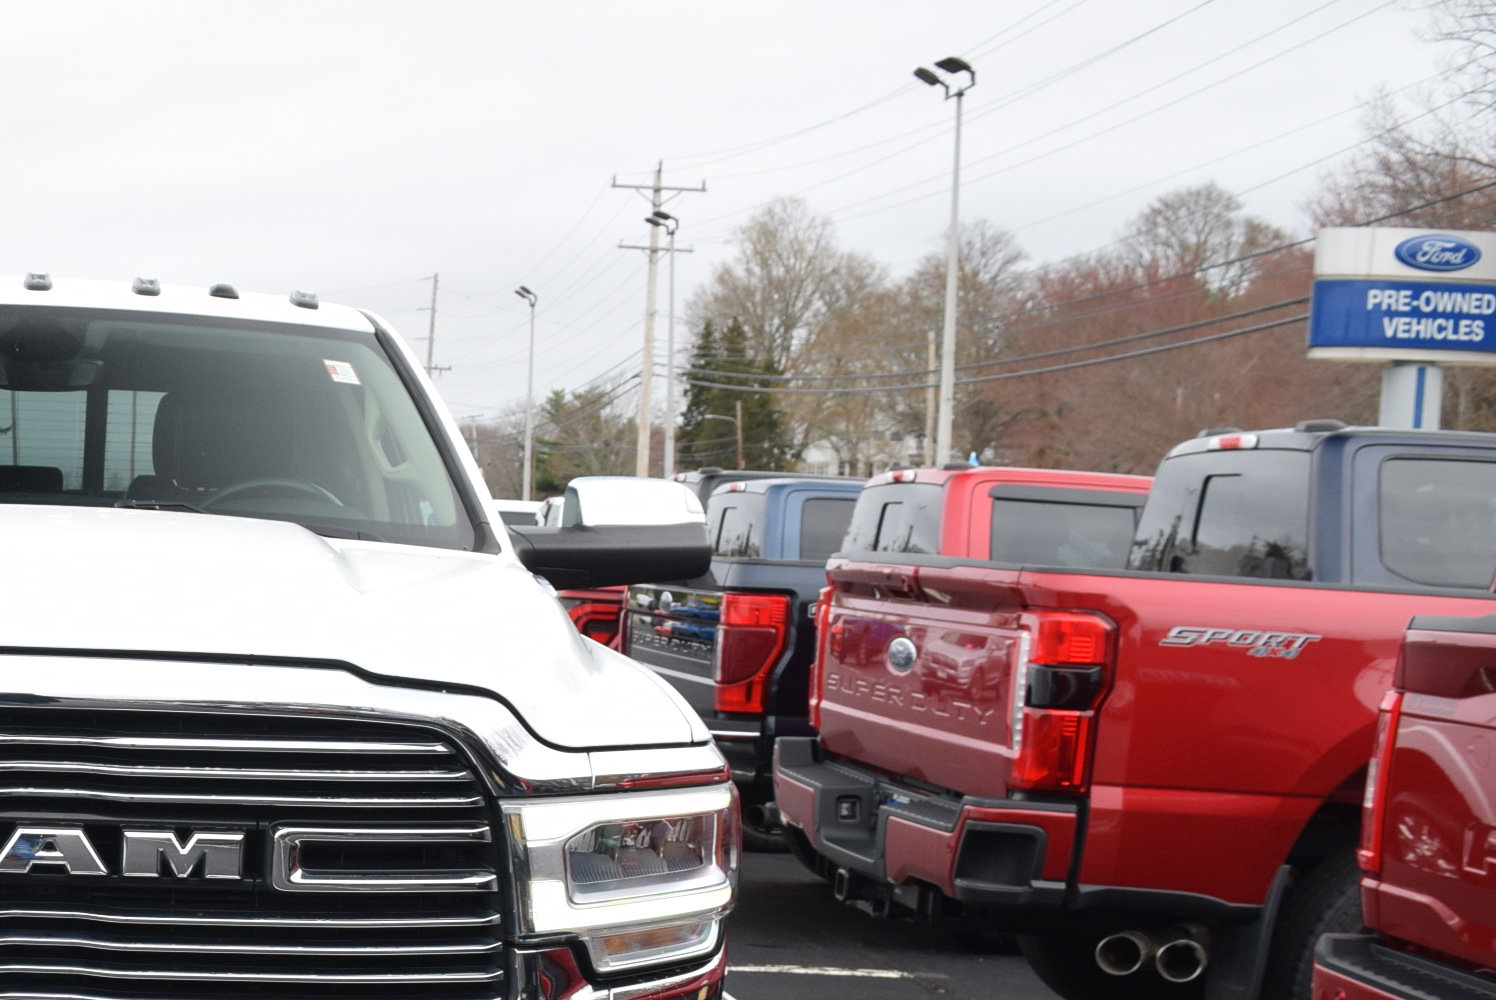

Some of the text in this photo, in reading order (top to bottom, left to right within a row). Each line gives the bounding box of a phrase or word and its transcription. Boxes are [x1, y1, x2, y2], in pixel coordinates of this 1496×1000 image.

[1416, 240, 1468, 264] Ford
[1366, 289, 1496, 315] PRE-OWNED
[1382, 317, 1485, 342] VEHICLES
[1159, 625, 1323, 649] SPORT
[827, 673, 995, 725] SUPER DUTY
